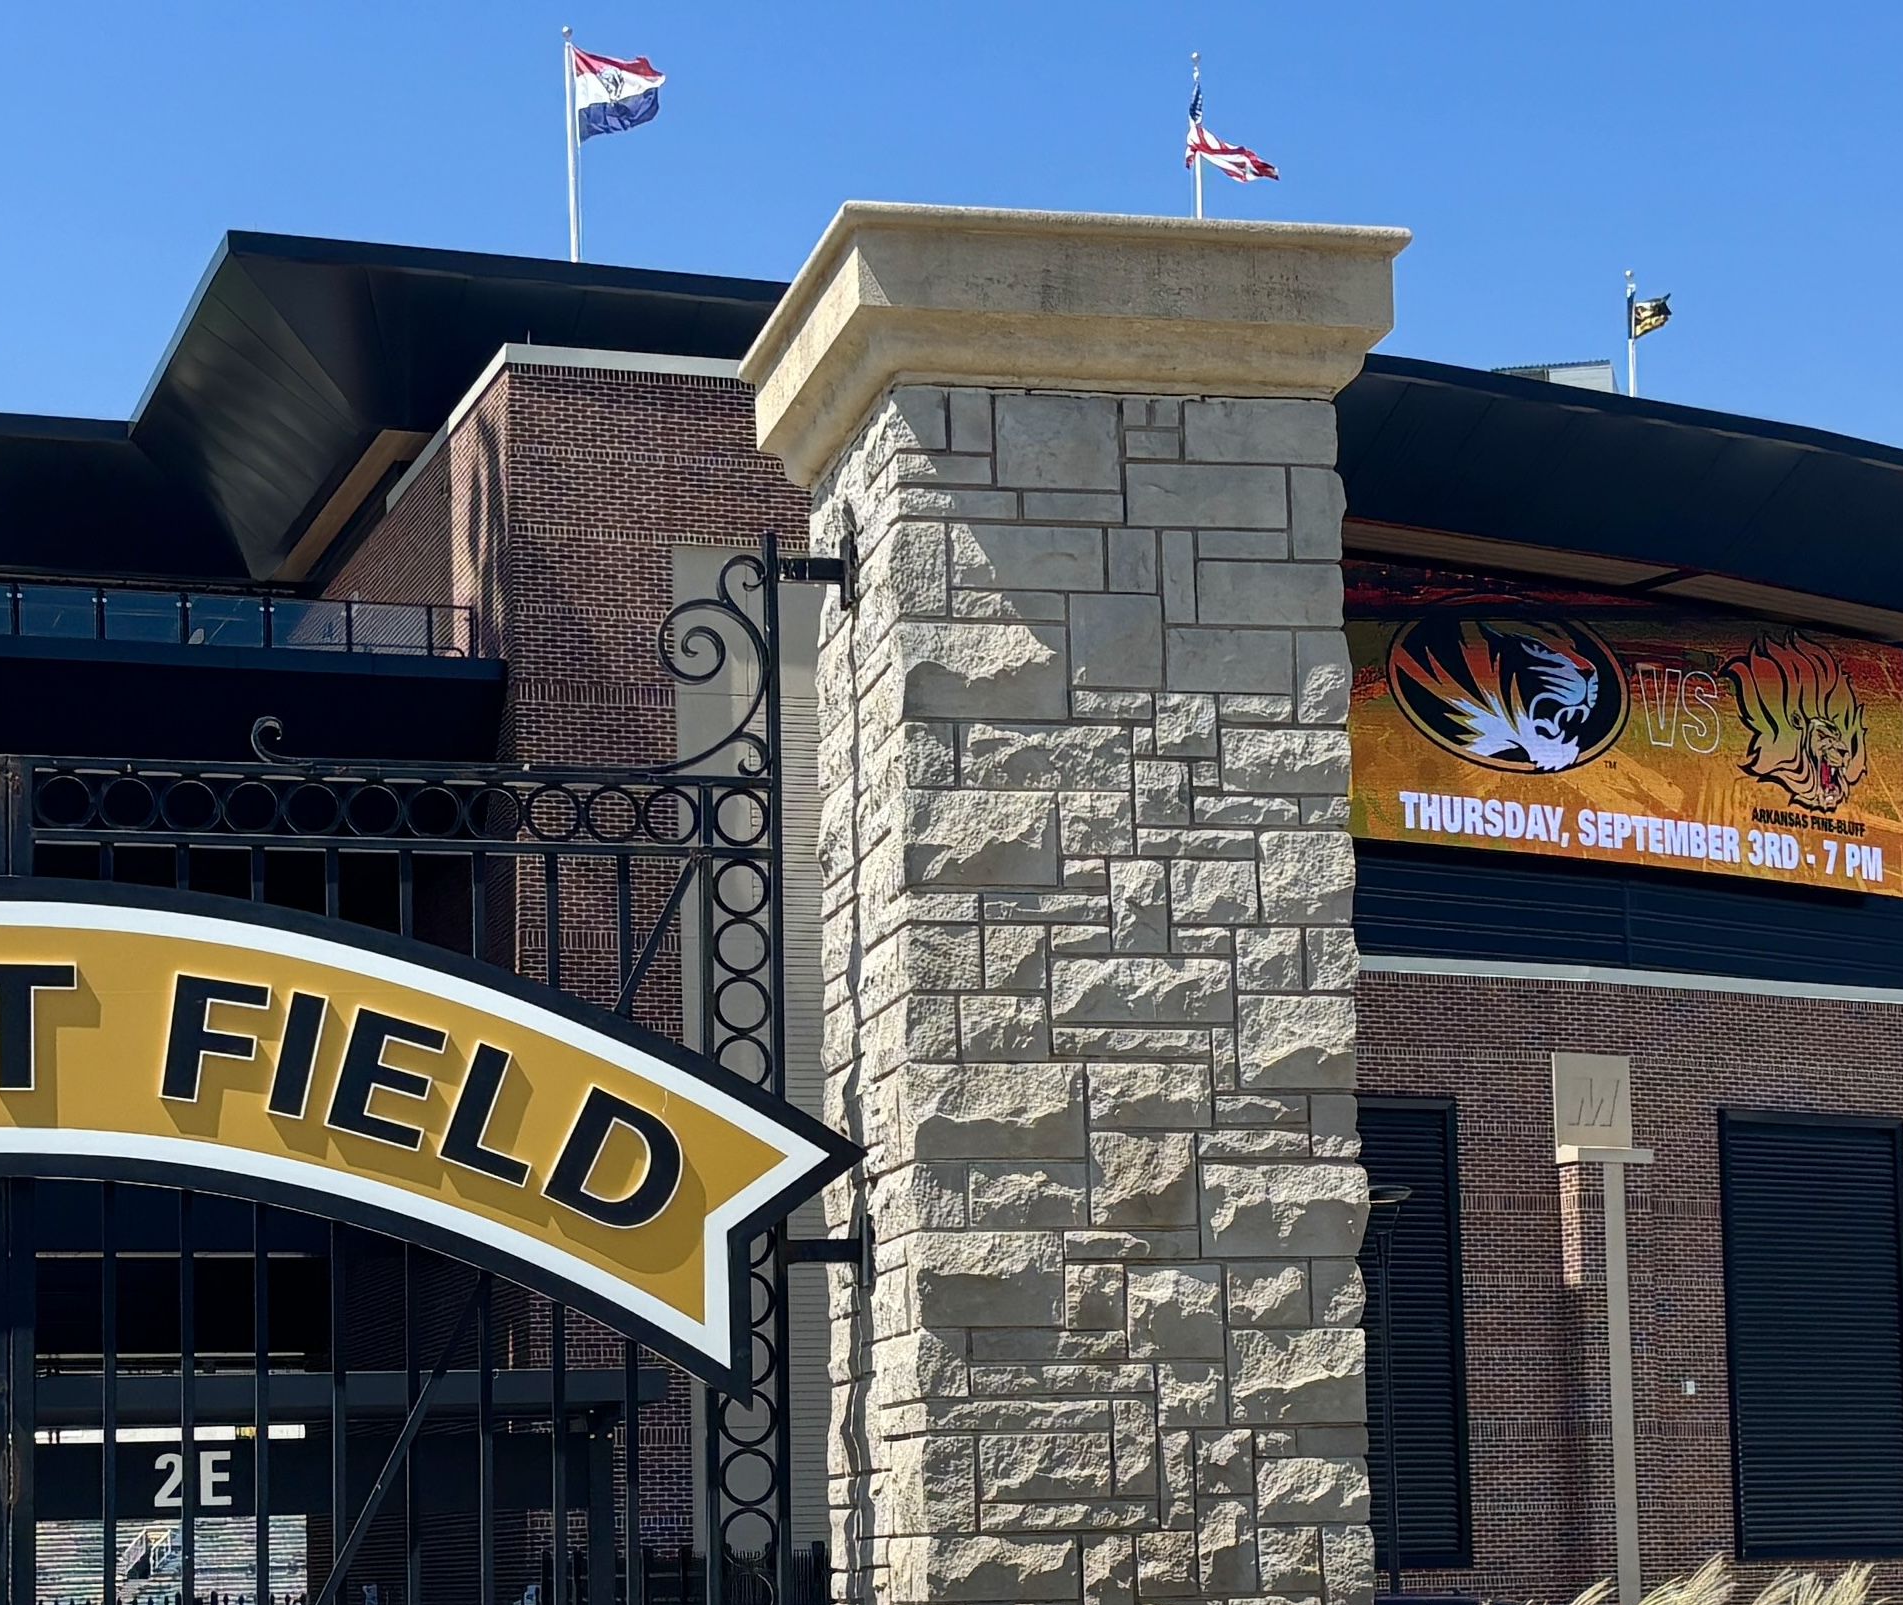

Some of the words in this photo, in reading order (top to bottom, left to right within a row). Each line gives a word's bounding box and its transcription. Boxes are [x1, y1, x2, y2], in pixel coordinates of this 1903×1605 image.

[1636, 663, 1719, 753] VS
[1399, 791, 1570, 848] THURSDAY,
[1578, 808, 1740, 863] SEPTEMBER
[1748, 829, 1799, 870] 3RD
[1823, 839, 1838, 875] 7
[1845, 843, 1883, 882] PM
[1751, 807, 1810, 829] ARKANSAS
[160, 972, 683, 1229] FIELD
[154, 1450, 233, 1508] 2E
